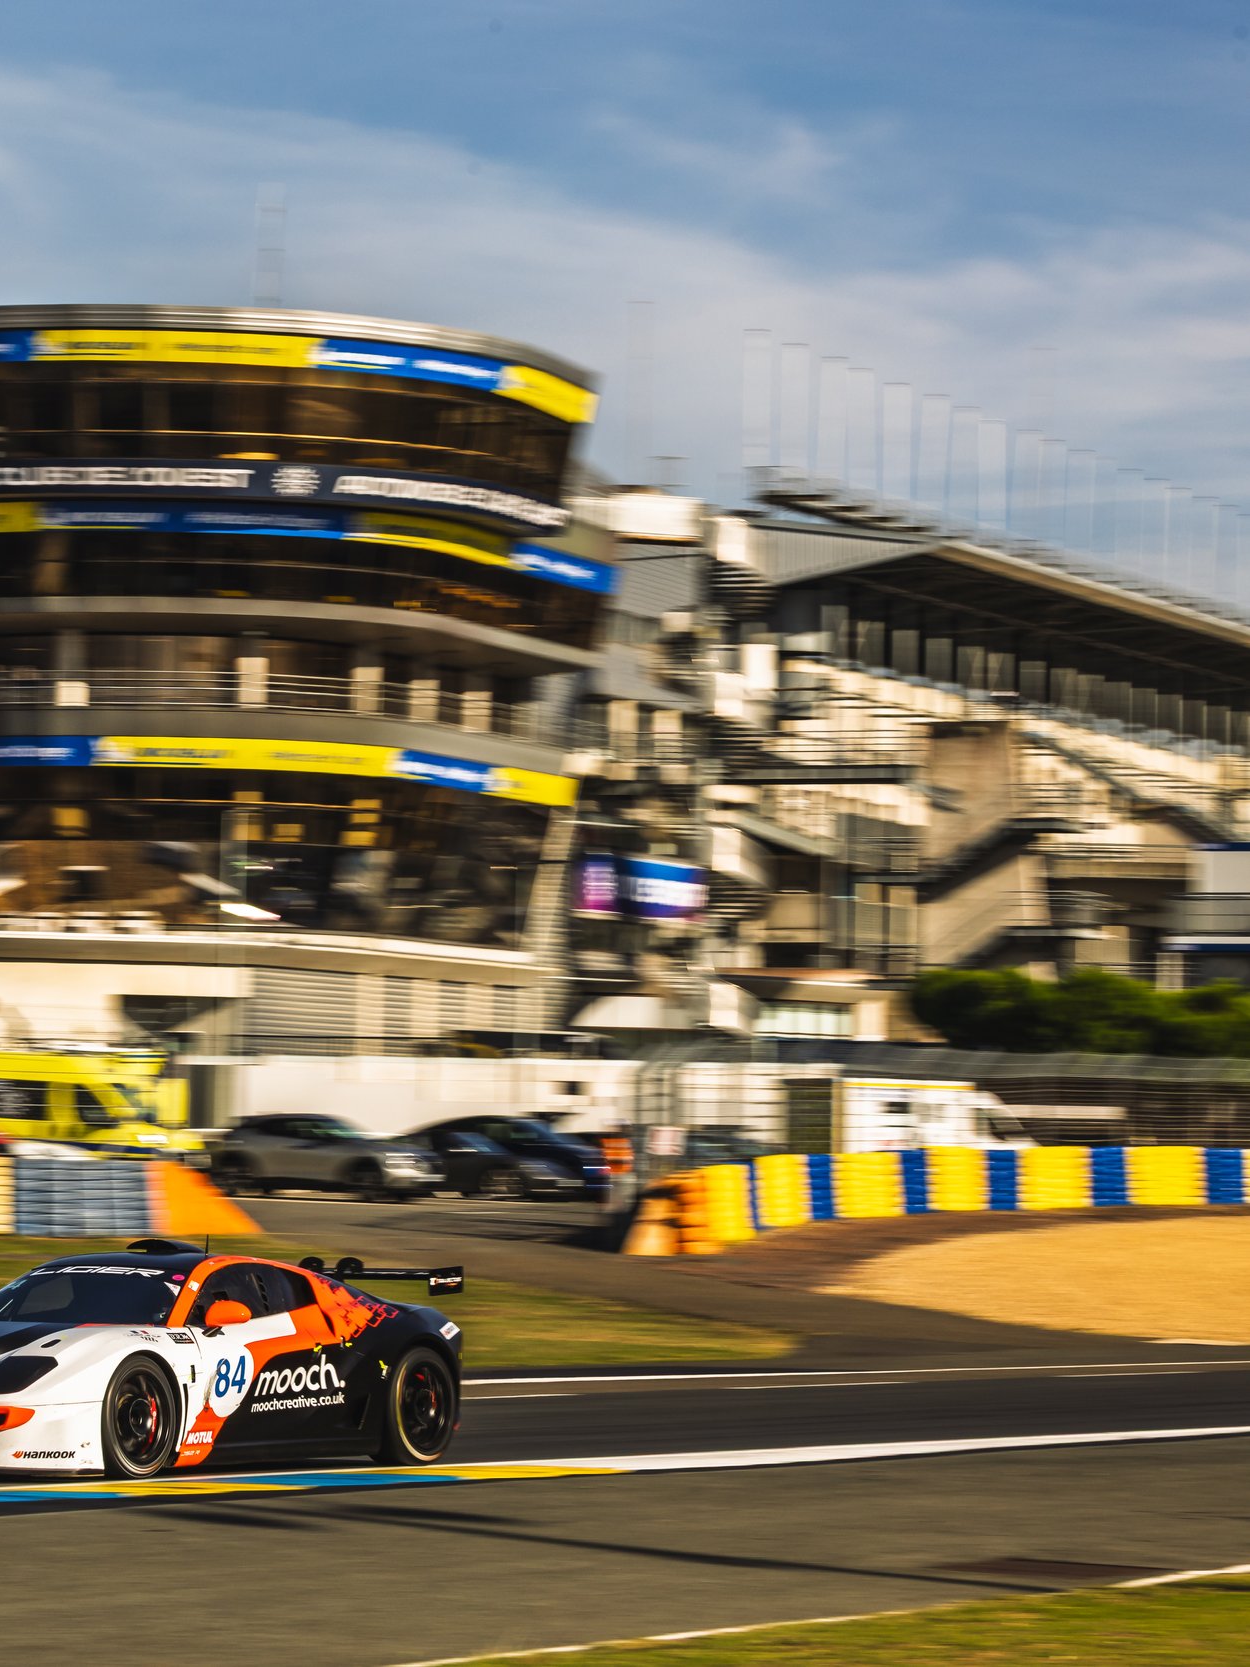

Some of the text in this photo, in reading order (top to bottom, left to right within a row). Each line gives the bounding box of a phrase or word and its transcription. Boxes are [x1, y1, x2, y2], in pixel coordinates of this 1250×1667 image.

[29, 1265, 166, 1278] LIGIER
[214, 1355, 247, 1399] 84
[250, 1392, 346, 1413] moochcreative.co.uk
[185, 1431, 213, 1445] MOTUL
